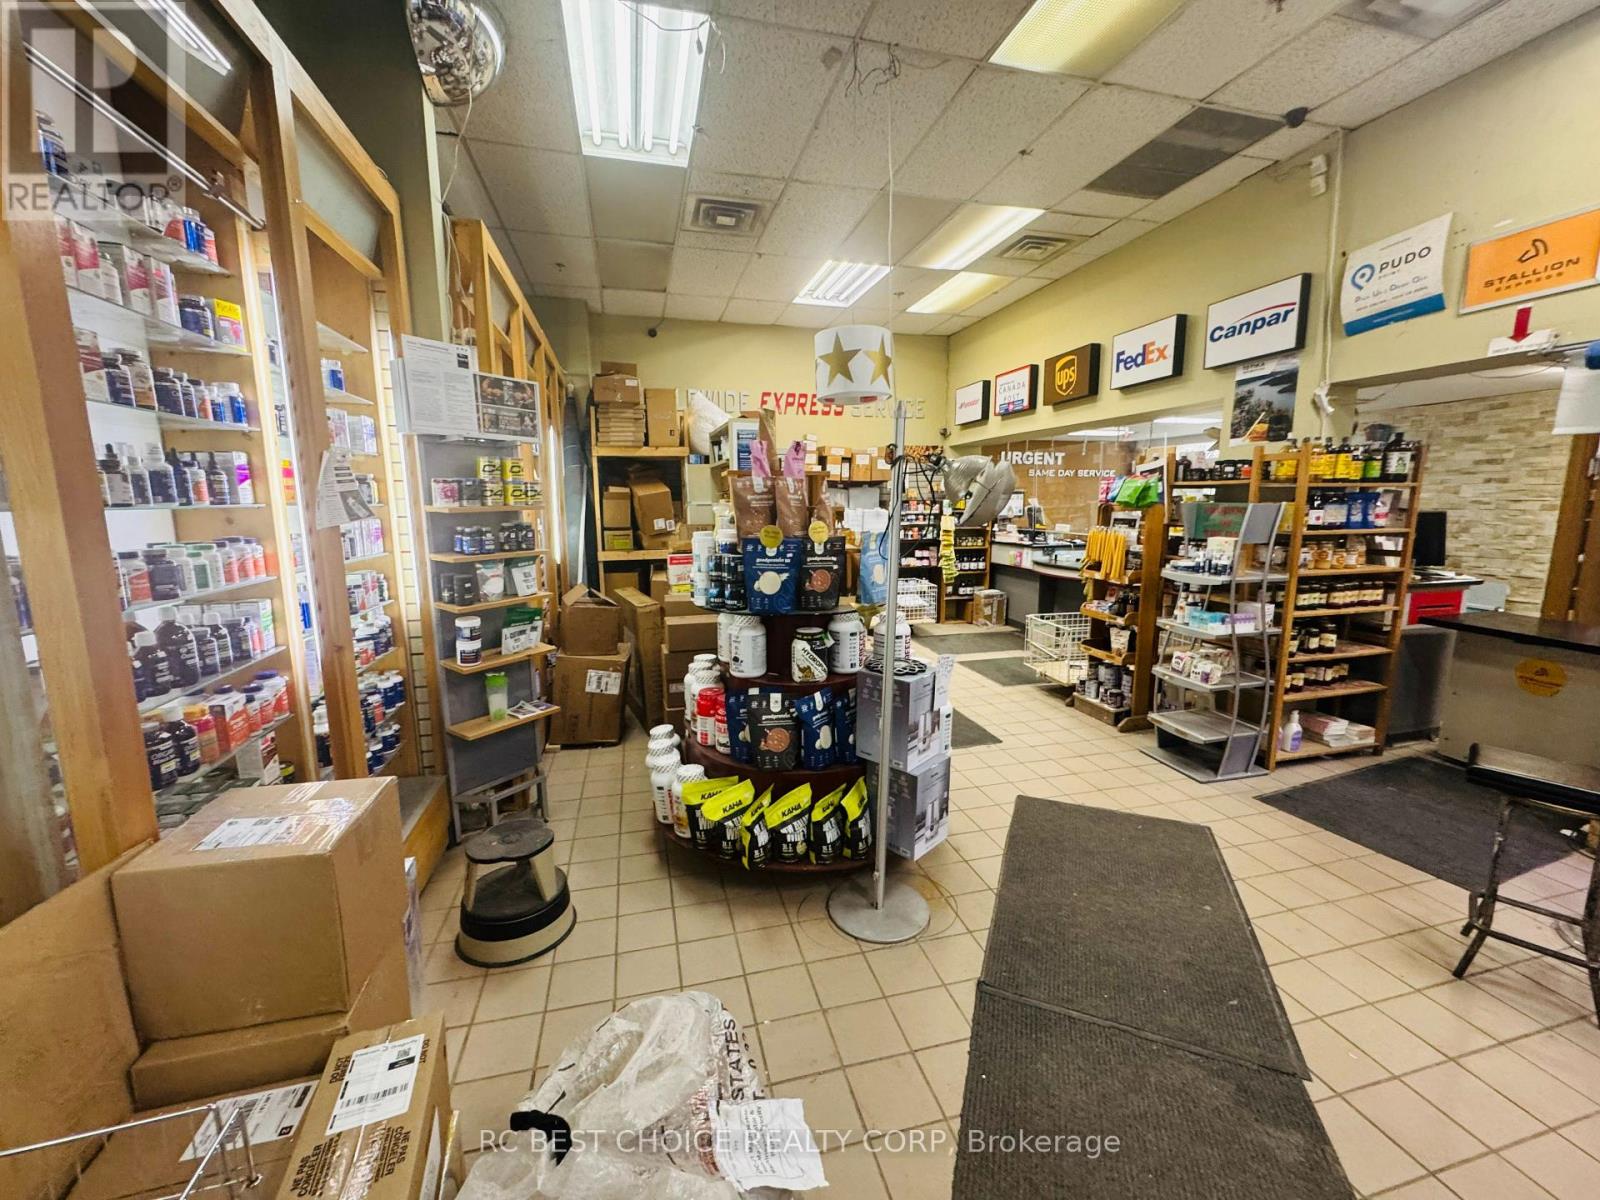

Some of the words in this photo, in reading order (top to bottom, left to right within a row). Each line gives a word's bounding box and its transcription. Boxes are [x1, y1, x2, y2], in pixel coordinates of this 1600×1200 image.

[1379, 246, 1432, 274] PUDO
[1483, 256, 1581, 288] STALLION
[1209, 307, 1296, 343] Canpar
[1115, 340, 1169, 374] FedEx
[1057, 366, 1076, 390] ups
[1000, 450, 1066, 466] URGENT
[1028, 469, 1056, 478] SAME
[1058, 469, 1076, 478] DAY
[1077, 469, 1116, 478] SERVICE
[722, 1017, 746, 1102] STATES
